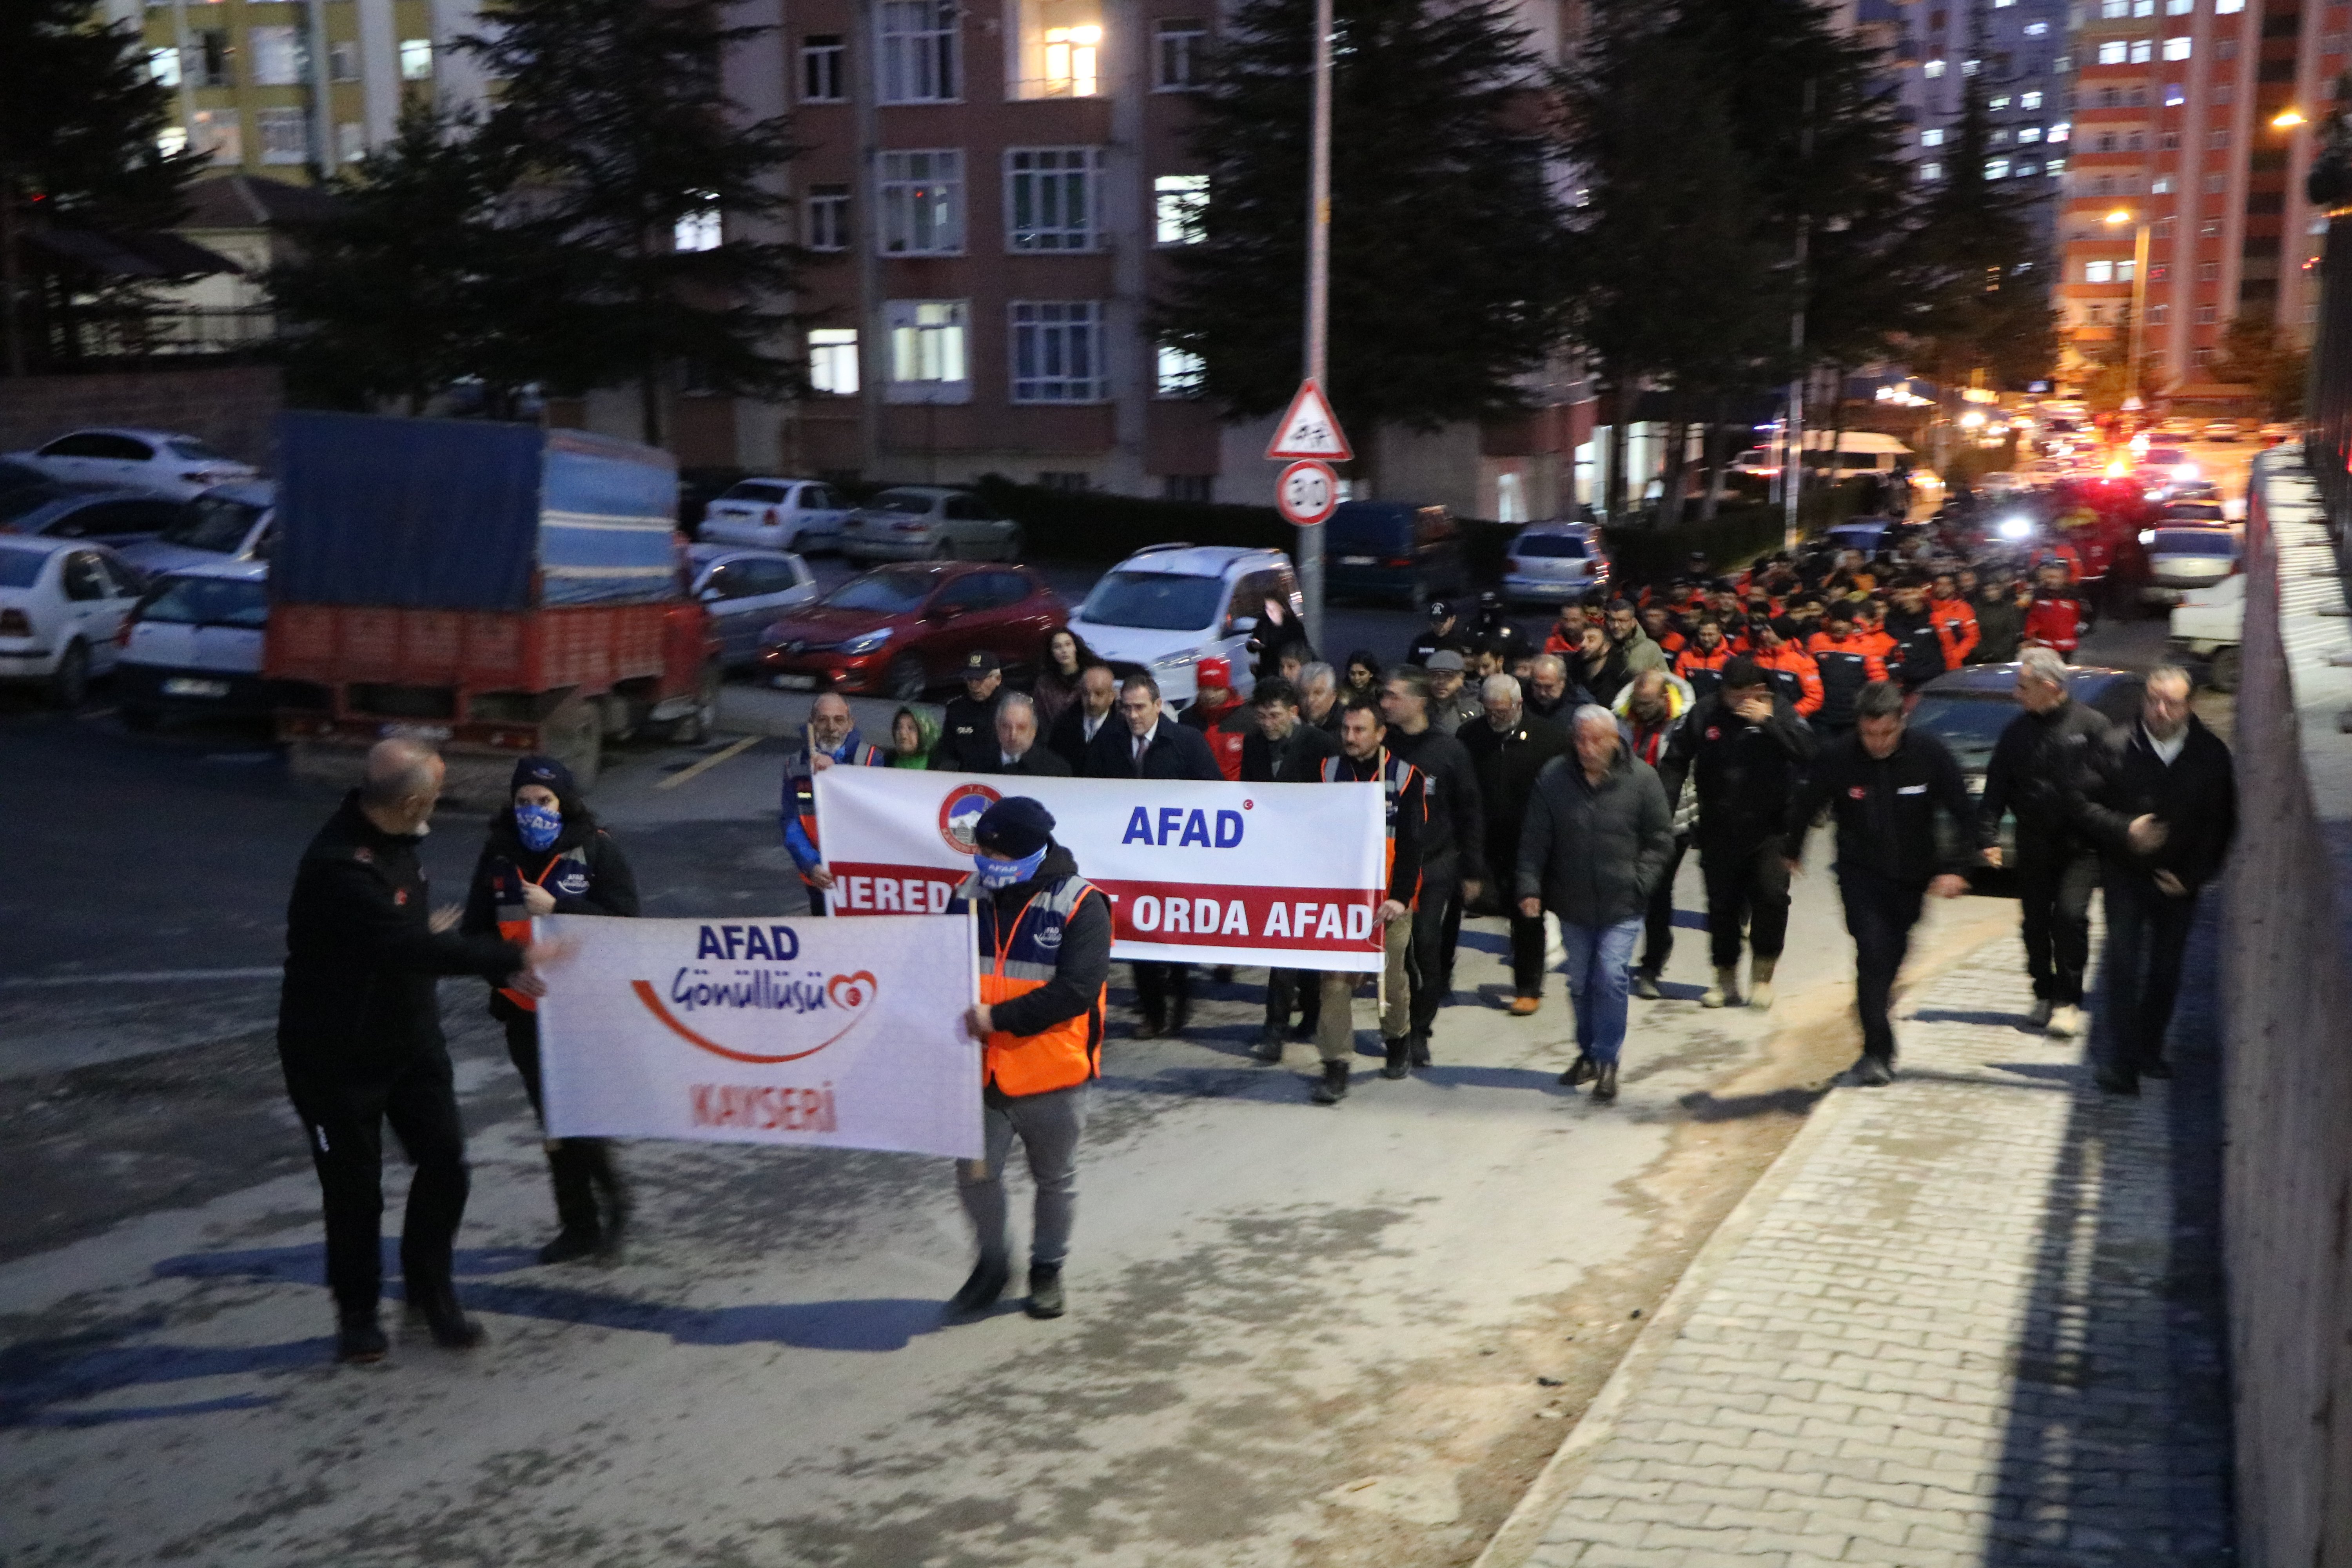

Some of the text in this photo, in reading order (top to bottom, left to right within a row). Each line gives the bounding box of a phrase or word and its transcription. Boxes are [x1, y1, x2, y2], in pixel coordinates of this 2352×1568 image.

[1289, 478, 1328, 506] 30
[1122, 806, 1244, 848] AFAD
[1132, 895, 1373, 940] ORDA AFAD
[696, 925, 800, 960] AFAD
[671, 967, 826, 1014] Gönüllüsü
